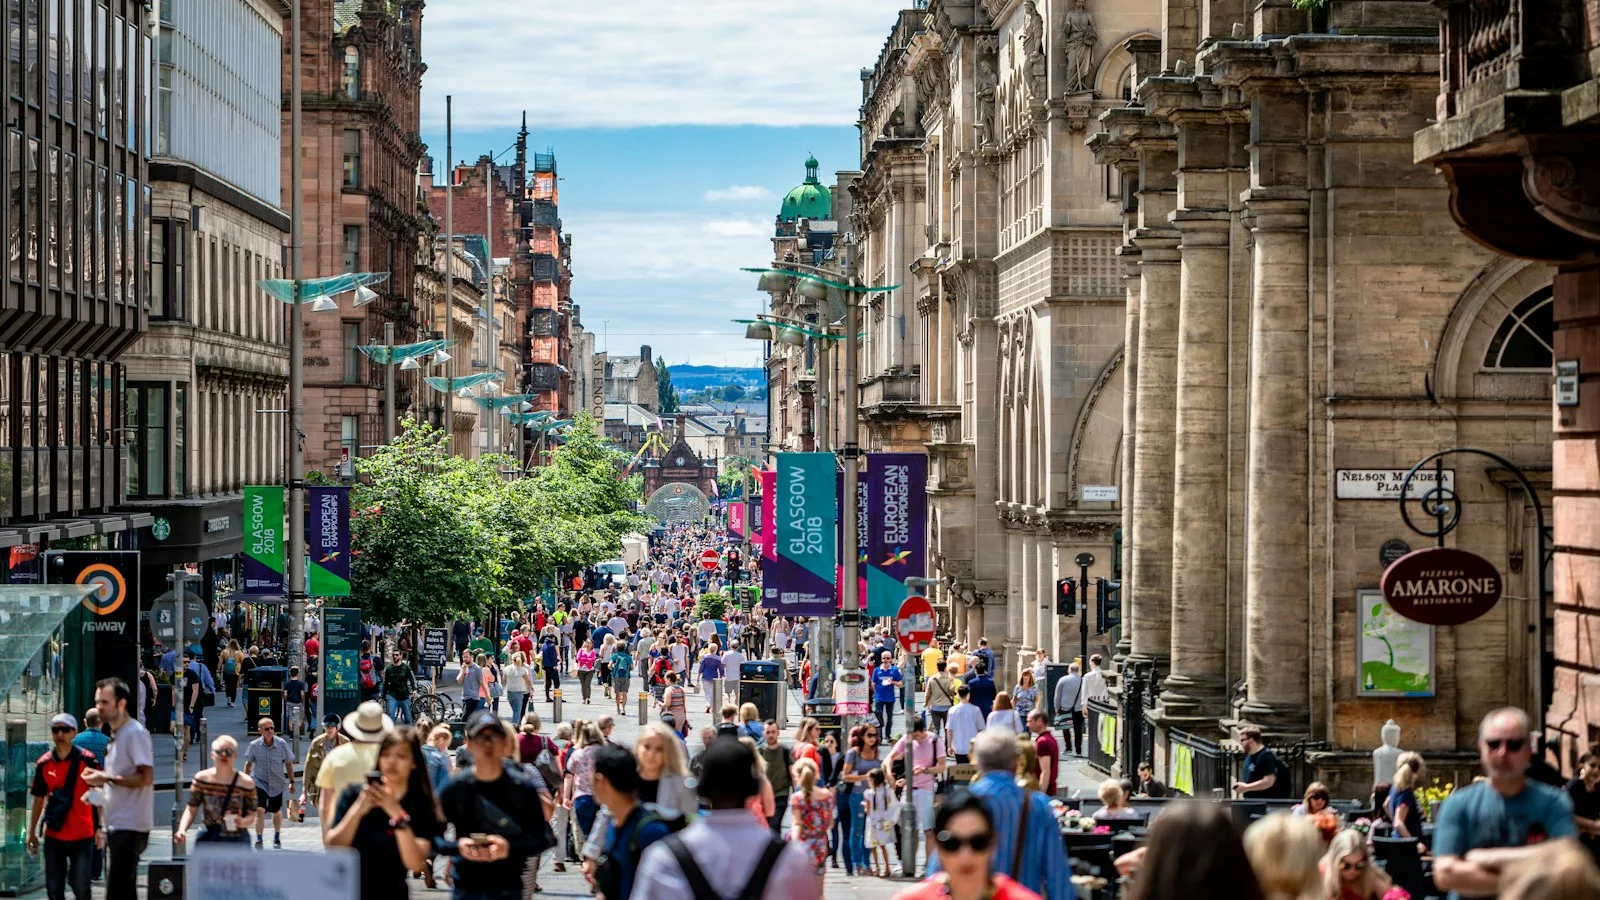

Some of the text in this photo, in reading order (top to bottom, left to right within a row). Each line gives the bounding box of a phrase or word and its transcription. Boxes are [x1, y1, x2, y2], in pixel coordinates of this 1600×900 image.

[1342, 471, 1448, 481] NELSON MNDEA
[322, 494, 331, 548] EUROPEAN
[789, 465, 806, 555] GLASGOW
[884, 464, 899, 544] EUROPEAN
[898, 465, 909, 544] CHAMPIONSHIPS
[252, 494, 264, 554] GLASGOW
[264, 528, 275, 554] 2018
[807, 516, 823, 554] 2018
[1391, 578, 1496, 597] AMARONE
[1420, 569, 1465, 577] PIZZERIA
[1413, 597, 1473, 605] RISTORANTE
